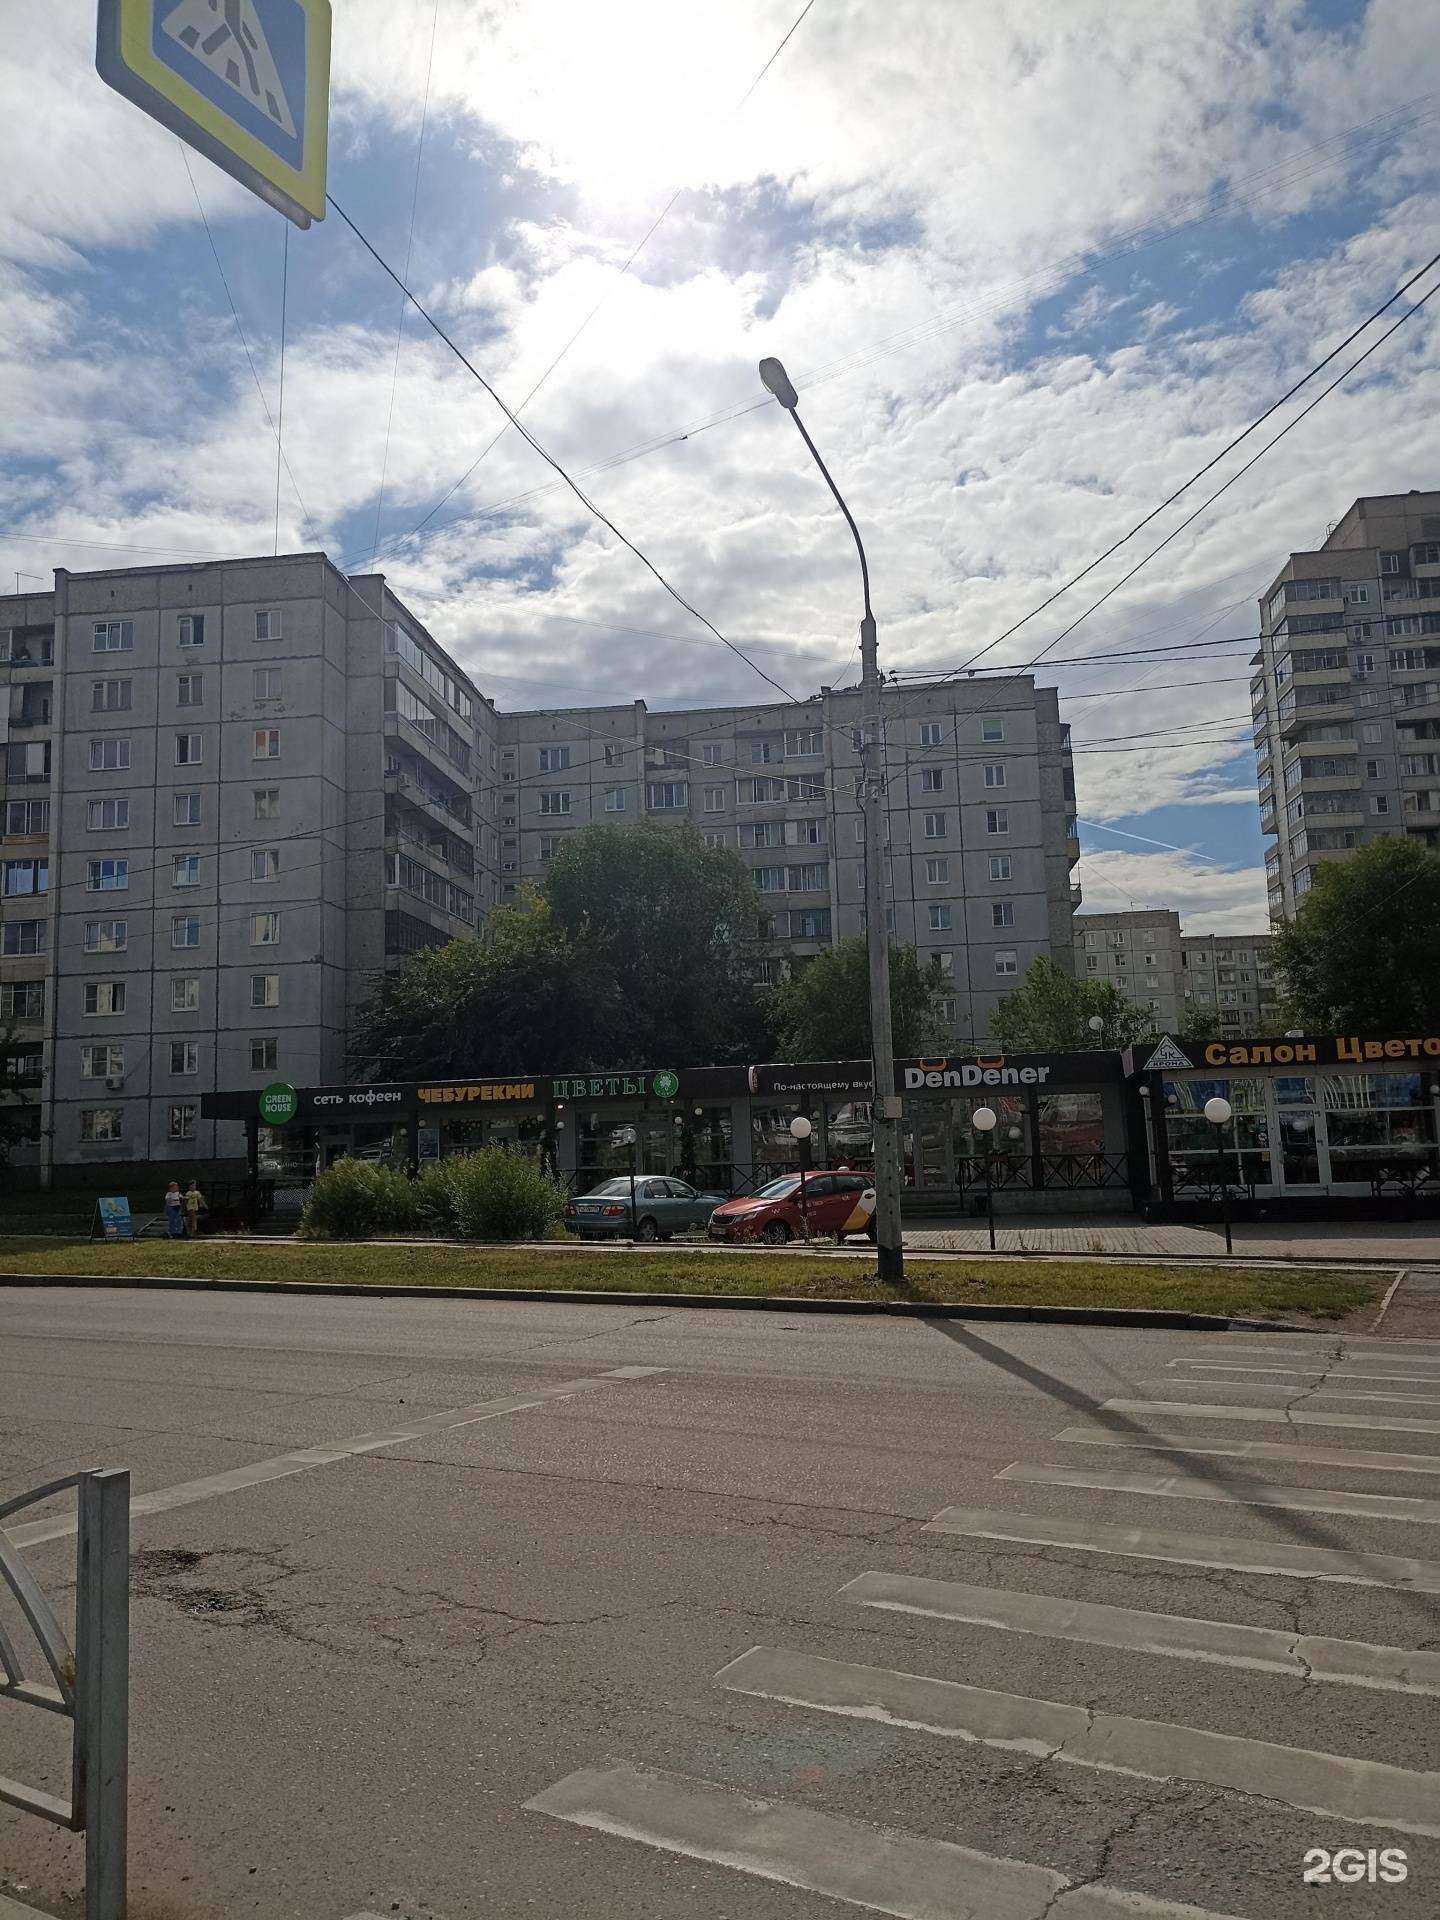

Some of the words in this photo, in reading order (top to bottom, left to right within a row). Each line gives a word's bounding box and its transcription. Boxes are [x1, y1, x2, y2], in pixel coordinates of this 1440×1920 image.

[1204, 1043, 1317, 1065] Салон
[773, 1081, 850, 1092] По-настоящему
[904, 1064, 1050, 1089] DenDener
[313, 1094, 344, 1105] сеть
[348, 1089, 402, 1106] кофеен
[417, 1083, 535, 1103] ЧЕБУРЕКМИ
[552, 1077, 647, 1100] ЦВЕТЫ
[265, 1094, 292, 1104] GREEN
